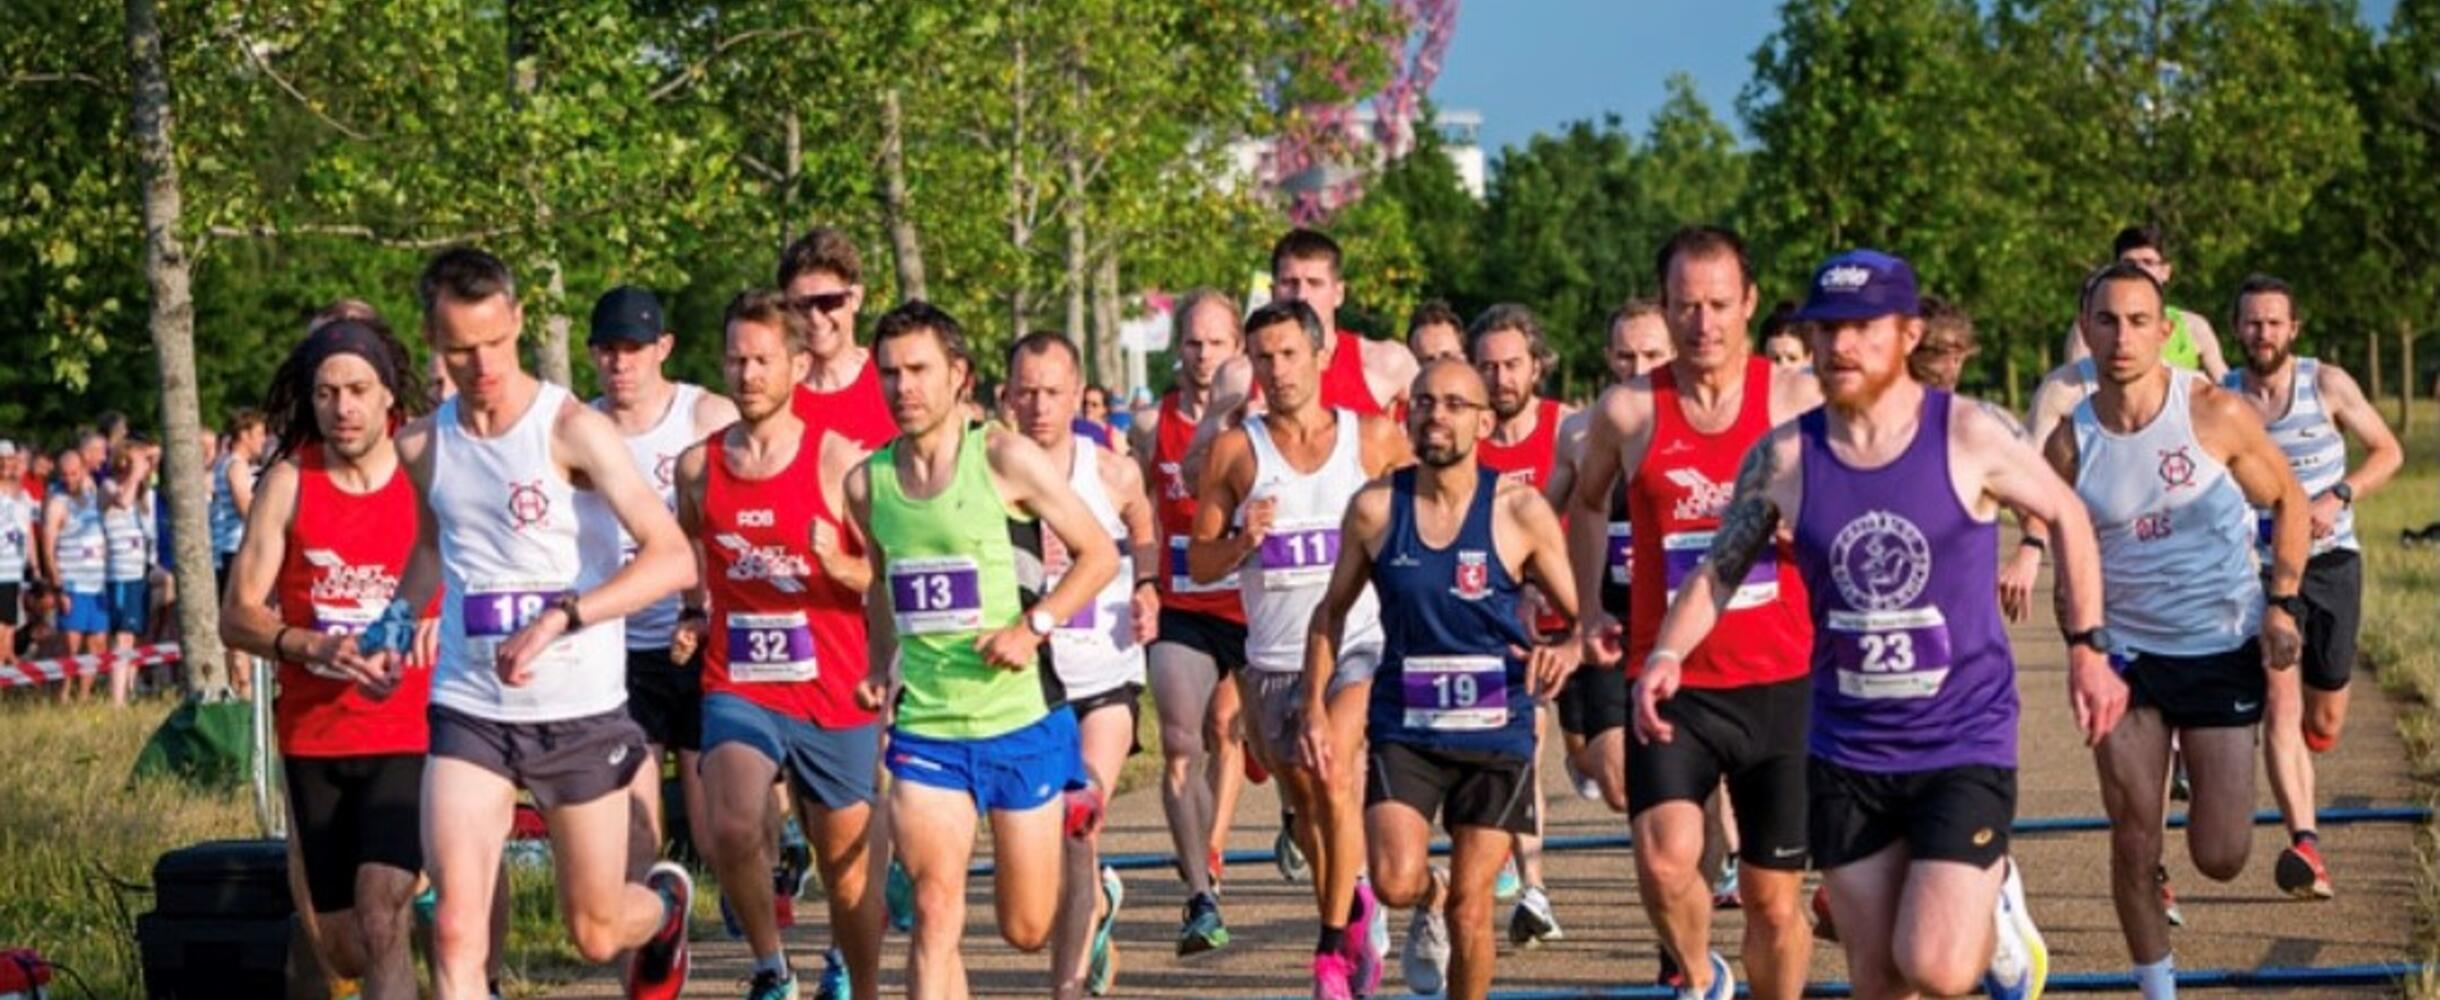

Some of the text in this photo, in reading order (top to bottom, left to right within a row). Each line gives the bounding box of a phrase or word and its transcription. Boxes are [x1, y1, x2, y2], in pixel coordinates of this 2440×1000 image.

[1287, 532, 1327, 564] 11
[911, 574, 952, 610] 13
[749, 631, 790, 662] 32
[1859, 631, 1915, 672] 23
[1432, 674, 1478, 707] 19
